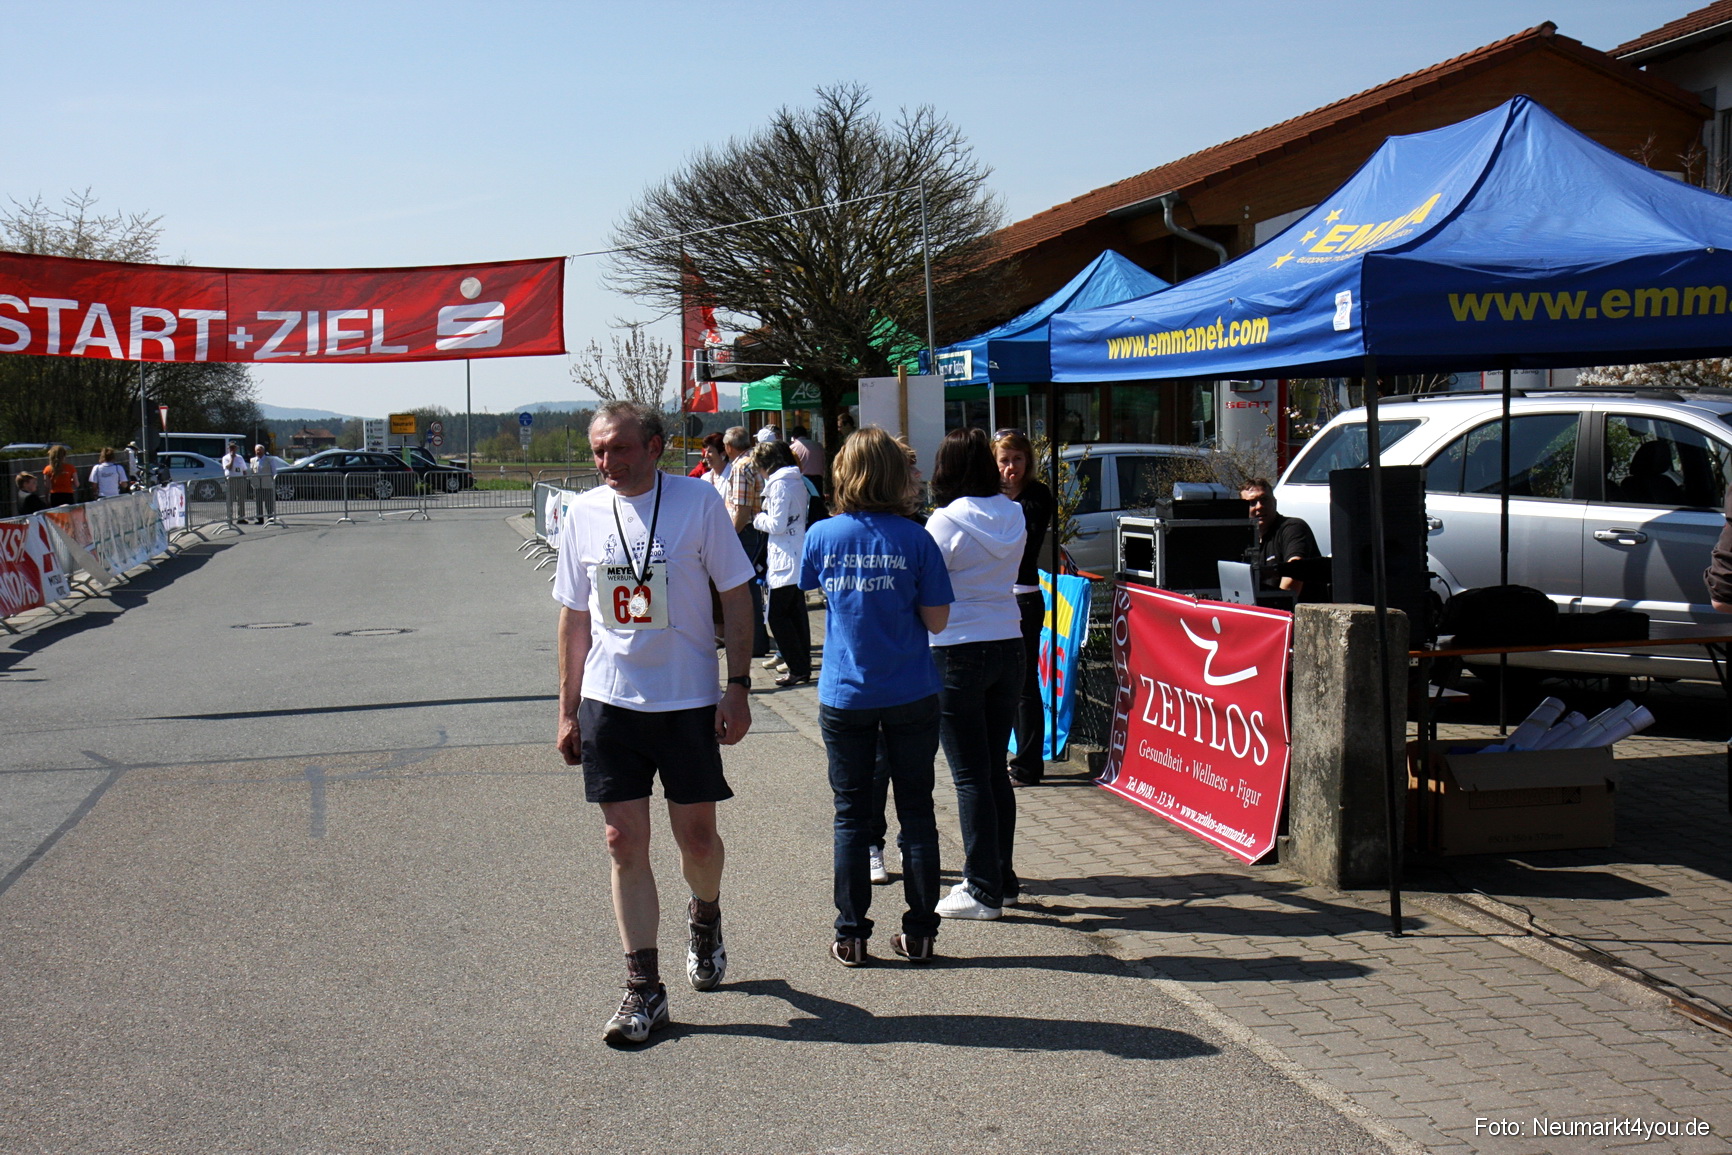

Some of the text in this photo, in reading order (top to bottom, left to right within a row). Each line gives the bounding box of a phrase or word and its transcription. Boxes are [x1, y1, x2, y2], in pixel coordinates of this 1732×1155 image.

[1449, 285, 1732, 322] www.emm
[1106, 315, 1269, 359] www.emmanet.com
[607, 567, 633, 575] MEYE
[843, 554, 907, 570] SENGENTHAL
[825, 575, 895, 592] GYMNASTIK
[1140, 674, 1269, 766] ZEITLOS
[1139, 739, 1262, 808] Gesundheit Wellness Figur
[1180, 804, 1256, 848] www.zeitlos-neumarkt.de
